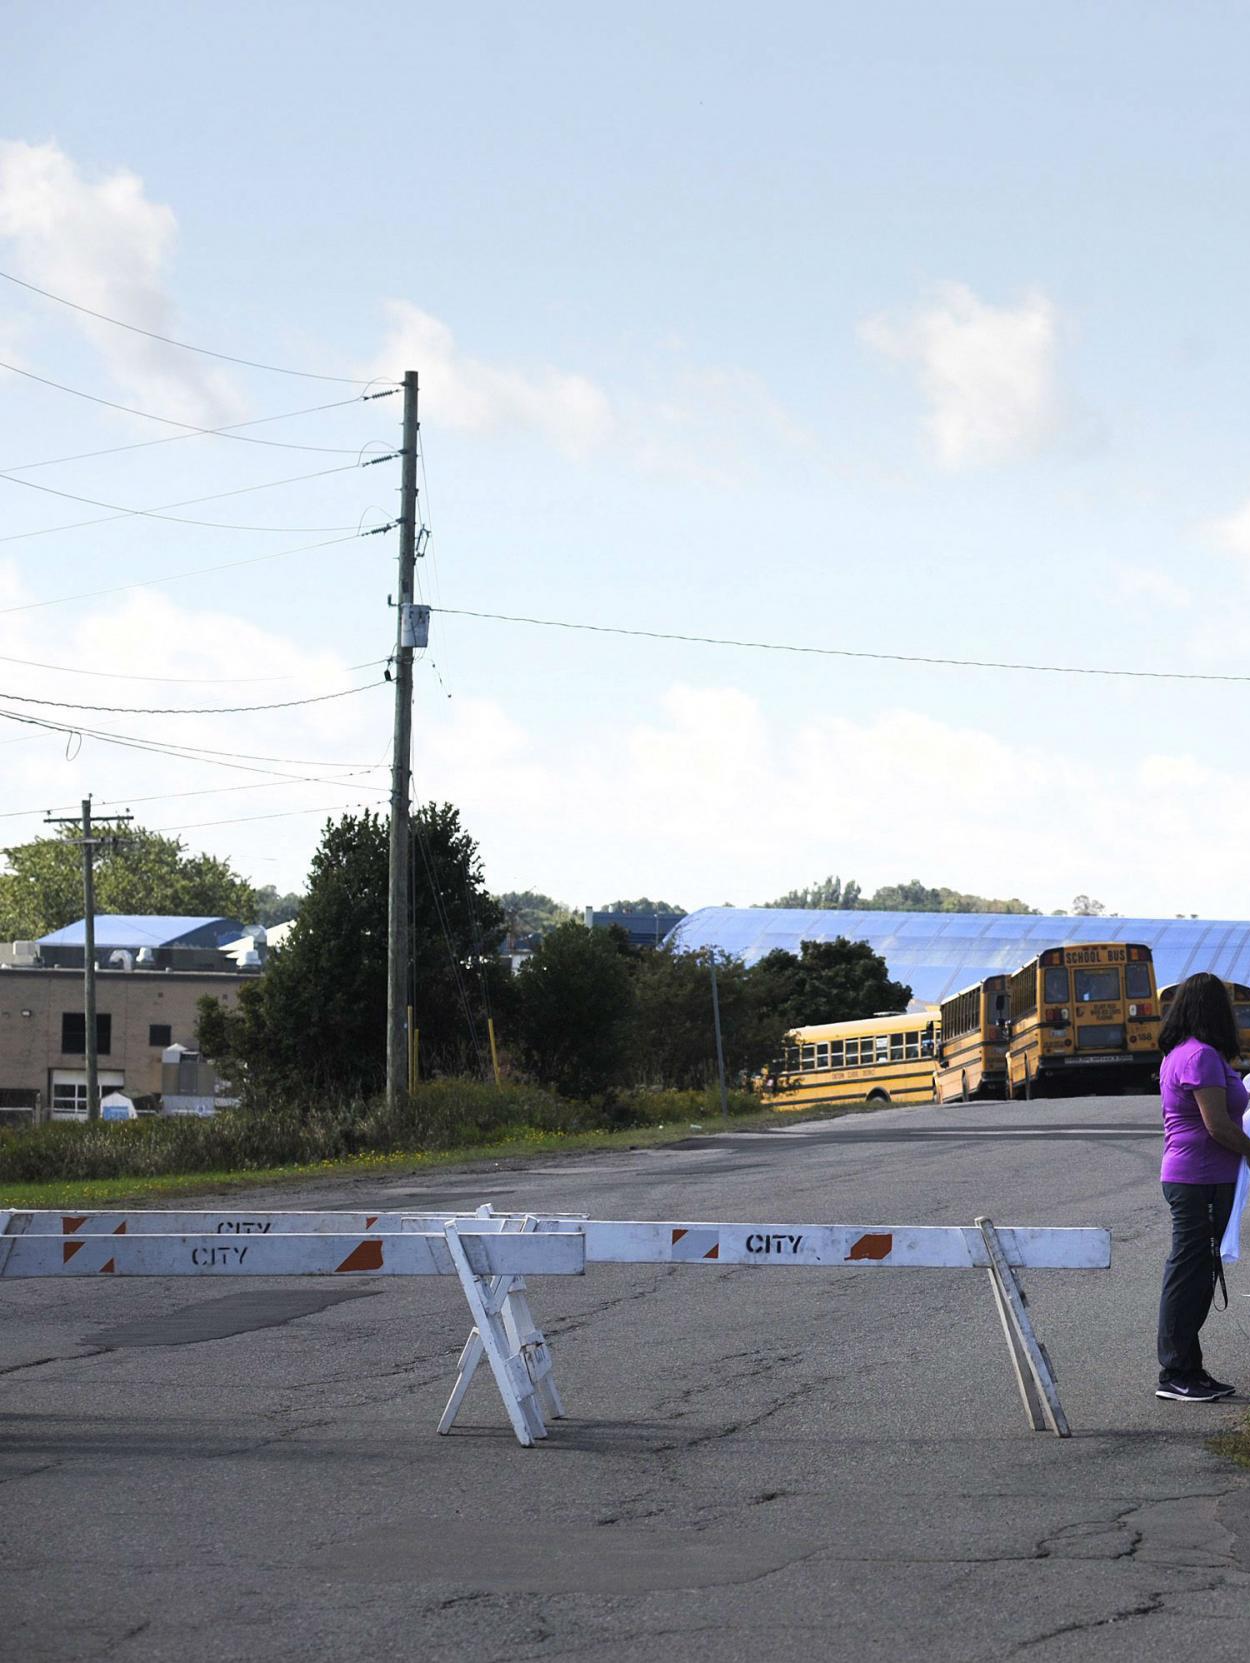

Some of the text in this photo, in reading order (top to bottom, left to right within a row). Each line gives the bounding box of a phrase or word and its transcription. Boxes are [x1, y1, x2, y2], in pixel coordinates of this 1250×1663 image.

[1065, 950, 1126, 964] SCHOOL BUS
[745, 1234, 803, 1254] CITY
[191, 1247, 248, 1265] CITY
